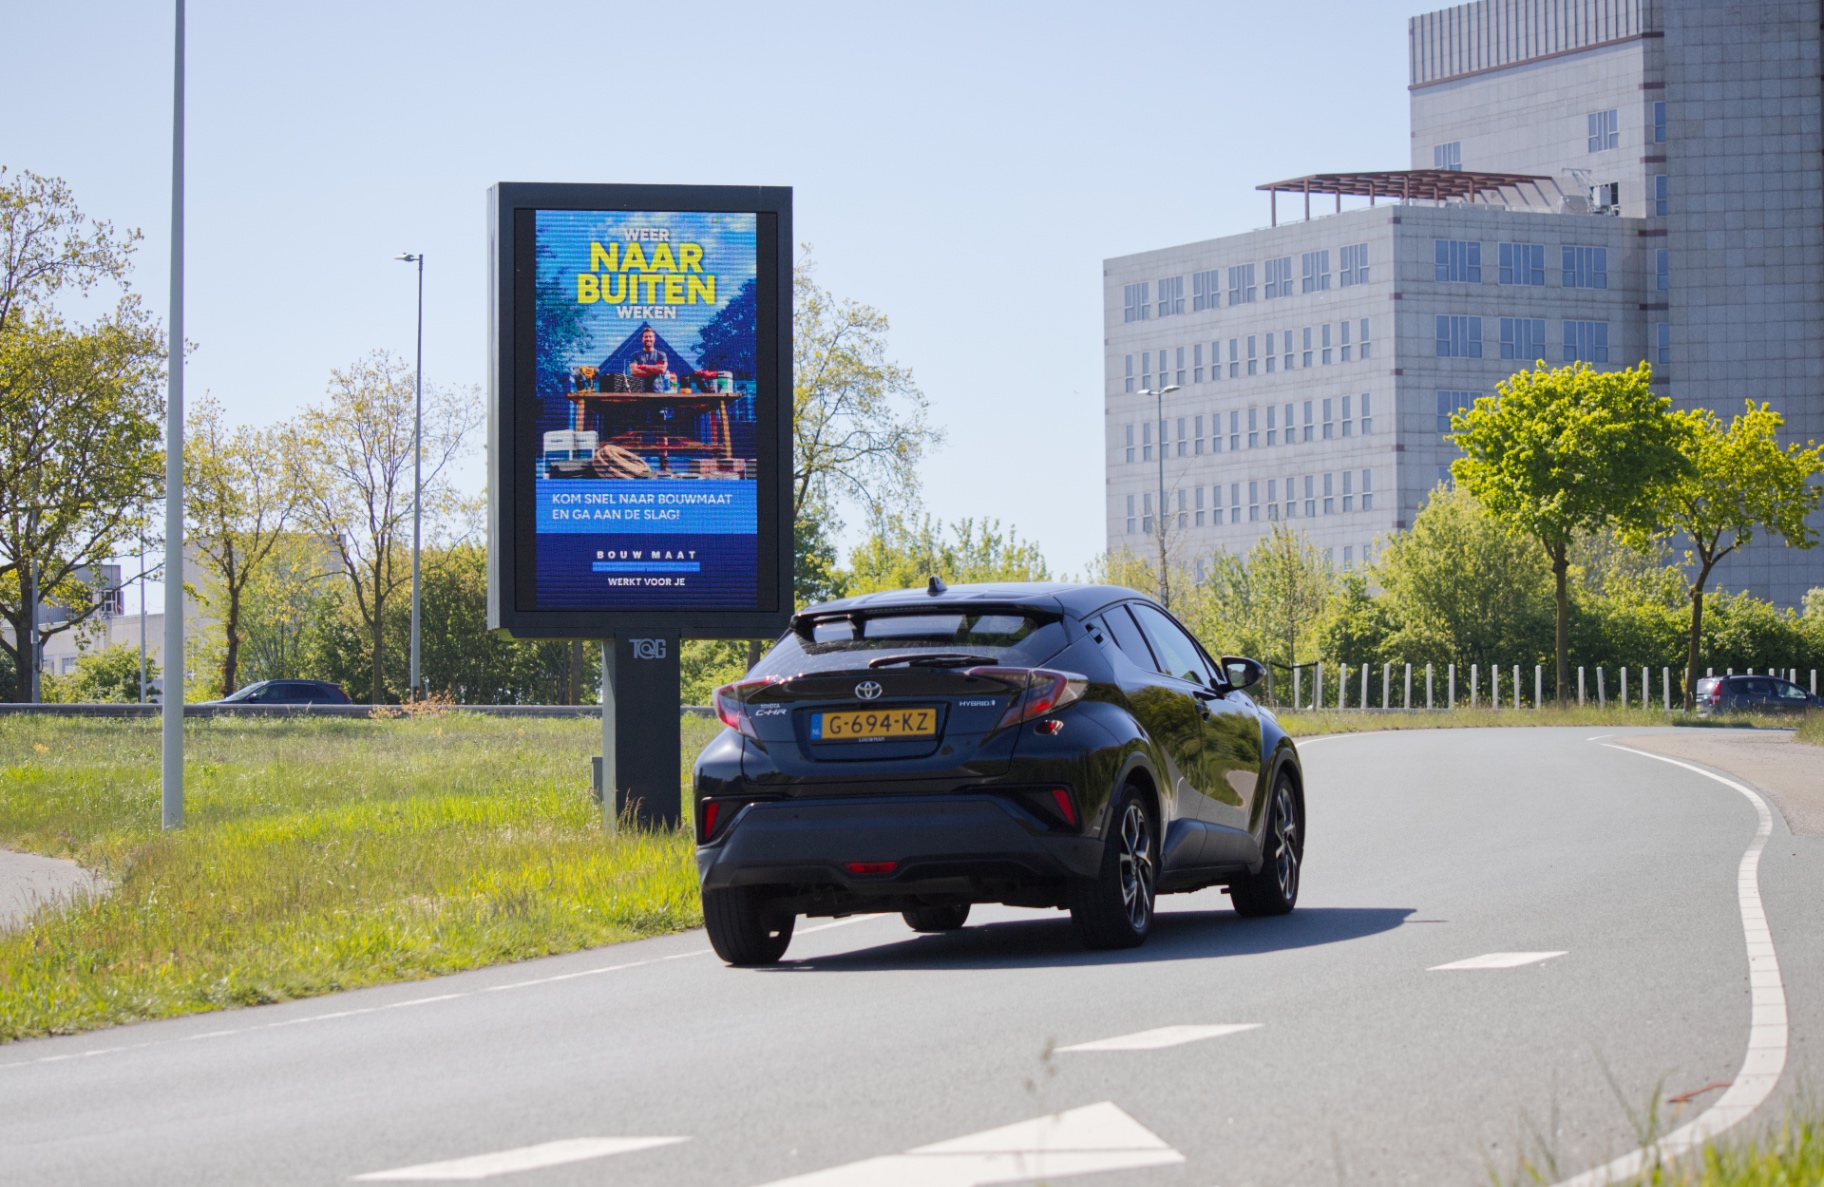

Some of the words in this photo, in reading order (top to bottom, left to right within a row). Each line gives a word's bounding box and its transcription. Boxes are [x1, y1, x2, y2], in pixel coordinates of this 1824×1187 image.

[623, 228, 670, 242] WEER
[589, 241, 704, 273] NAAR
[577, 273, 716, 305] BUITEN
[617, 305, 677, 319] WEKEN
[552, 493, 581, 505] KOM
[584, 493, 616, 505] SNEL
[619, 493, 655, 505] NAAR
[658, 493, 732, 505] BOUWMAAT
[552, 509, 570, 520] EN
[572, 509, 591, 520] GA
[593, 509, 621, 520] AAN
[624, 509, 641, 520] DE
[643, 509, 681, 521] SLAG!
[607, 577, 642, 587] WERKT
[644, 577, 672, 587] VOOR
[674, 577, 686, 587] JE
[829, 713, 928, 734] G-694-KZ
